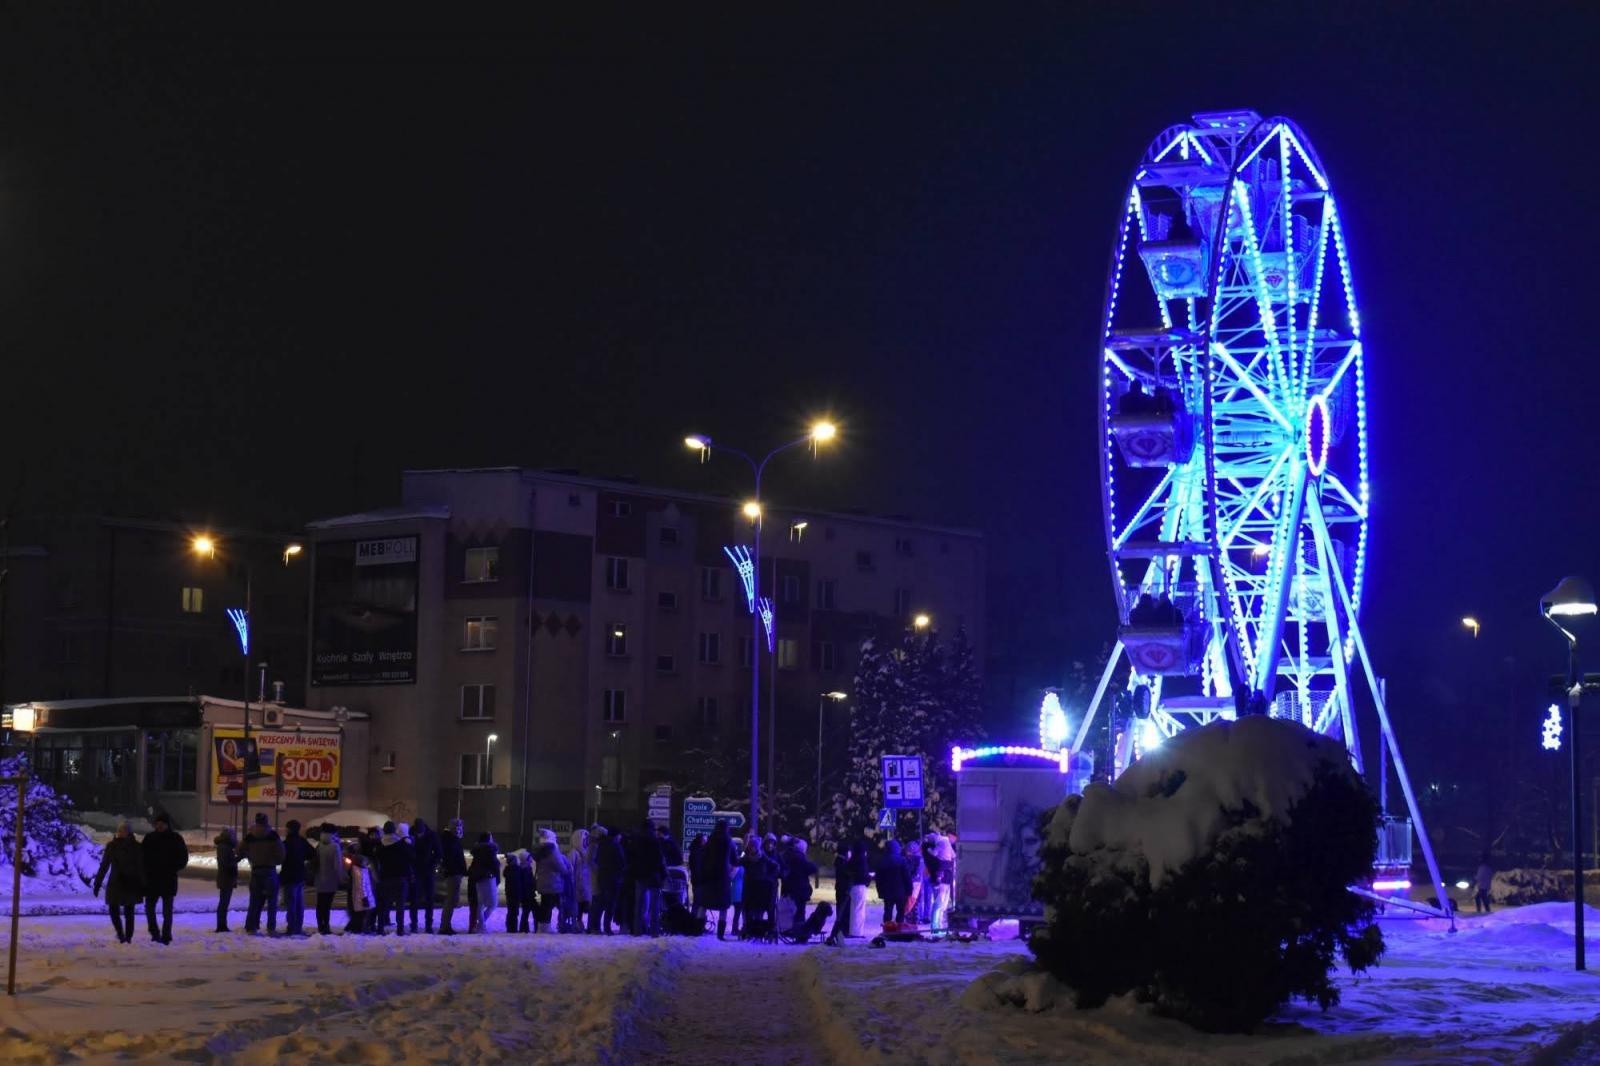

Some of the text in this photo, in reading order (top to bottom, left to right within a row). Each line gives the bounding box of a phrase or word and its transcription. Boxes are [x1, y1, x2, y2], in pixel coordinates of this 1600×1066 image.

[359, 540, 415, 557] MEBROLL
[259, 735, 295, 745] PRZECENY
[295, 734, 306, 745] NA
[283, 758, 321, 781] 300
[300, 789, 327, 799] expert
[688, 803, 708, 812] Opole
